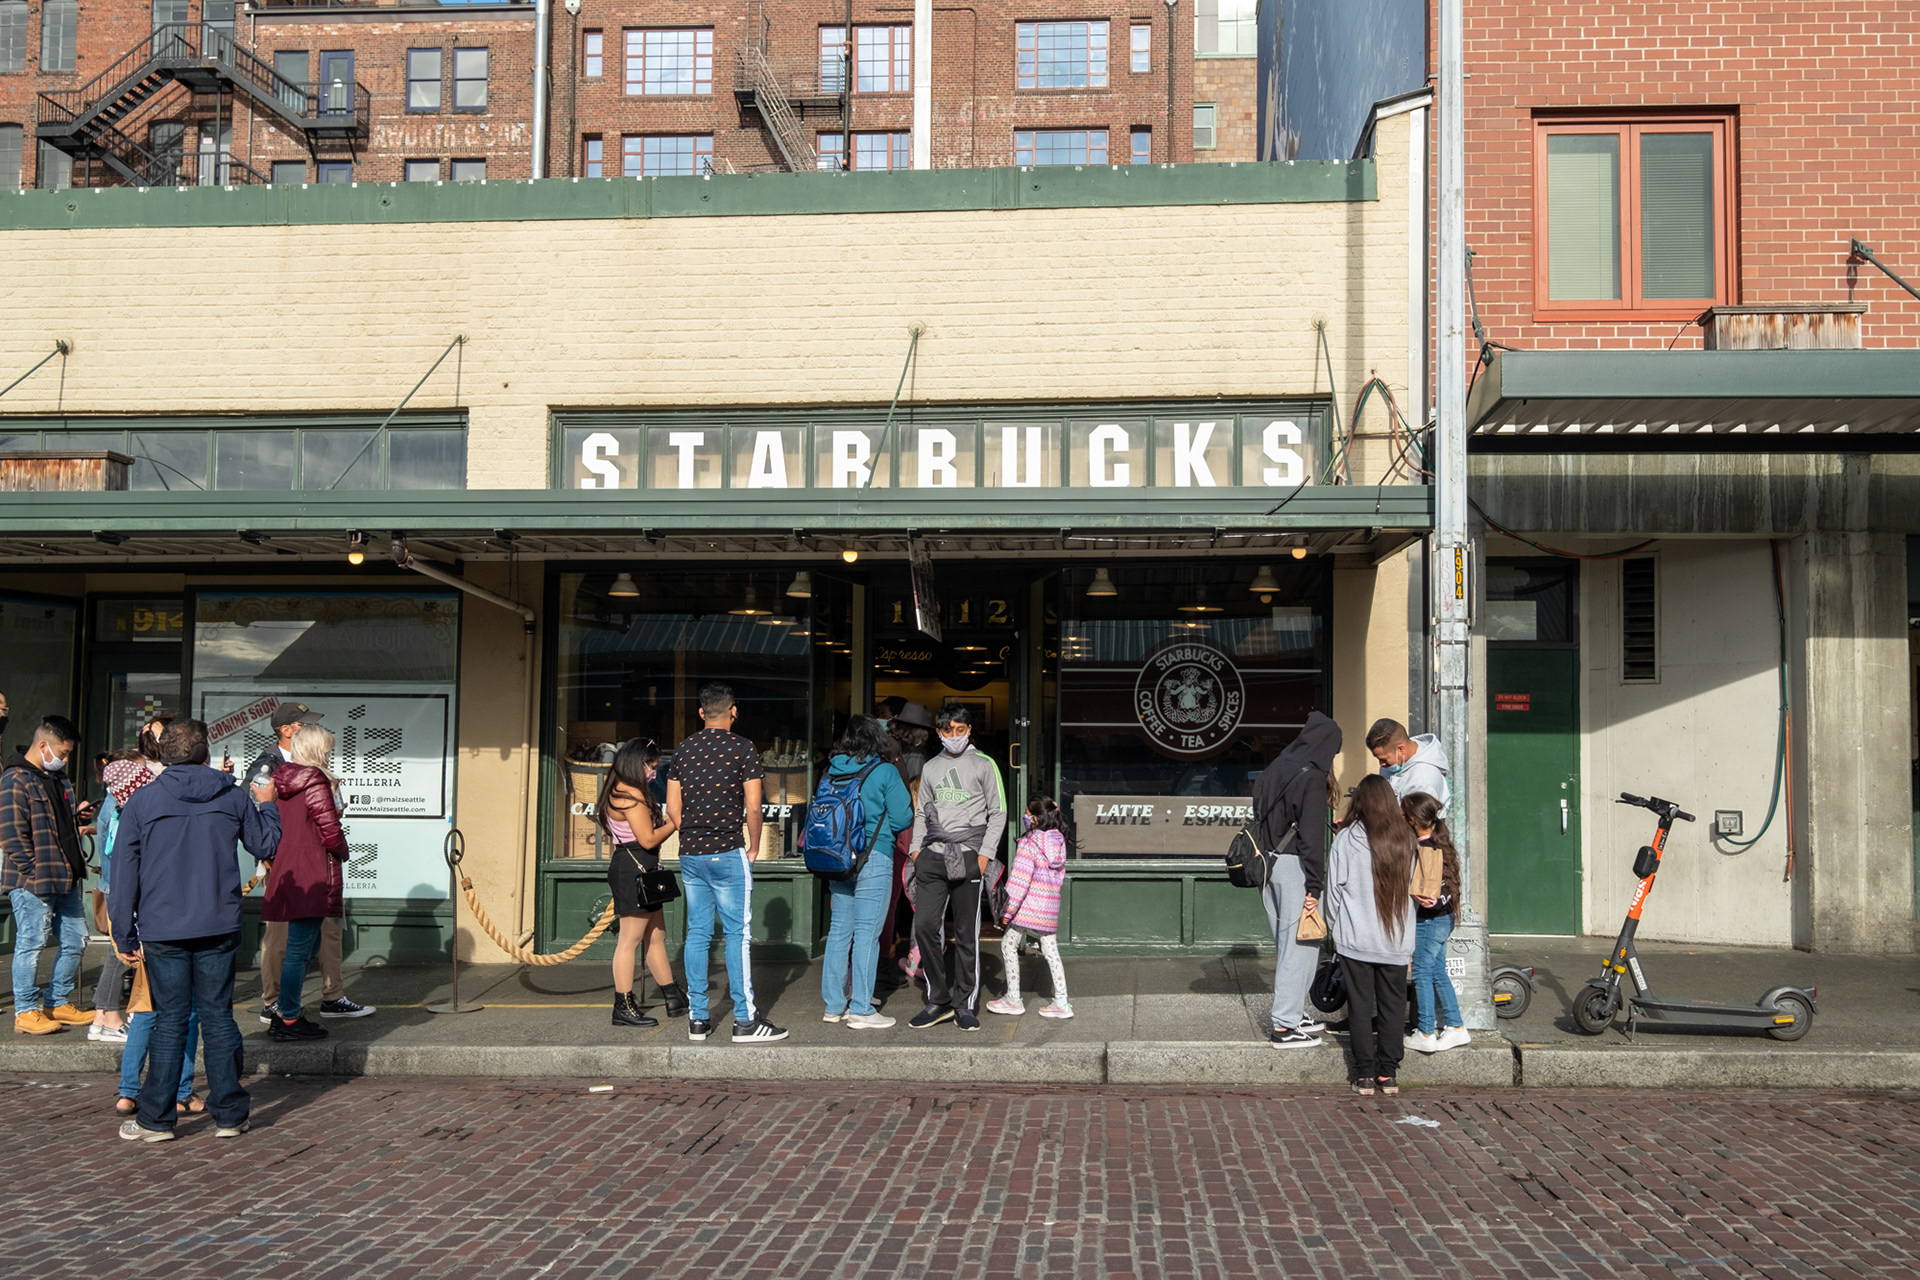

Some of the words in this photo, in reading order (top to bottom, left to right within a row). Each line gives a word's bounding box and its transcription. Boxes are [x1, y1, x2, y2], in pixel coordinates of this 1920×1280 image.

[581, 420, 1304, 489] STARBUCKS
[892, 600, 1008, 624] 112
[1155, 648, 1225, 671] STARBUCKS
[208, 710, 250, 740] COMING
[248, 697, 277, 721] SOON
[1139, 690, 1167, 736] COFFEE
[1181, 735, 1205, 747] TEA
[1218, 690, 1240, 731] SPICES
[1096, 804, 1154, 817] LATTE
[1184, 805, 1255, 818] ESPRES
